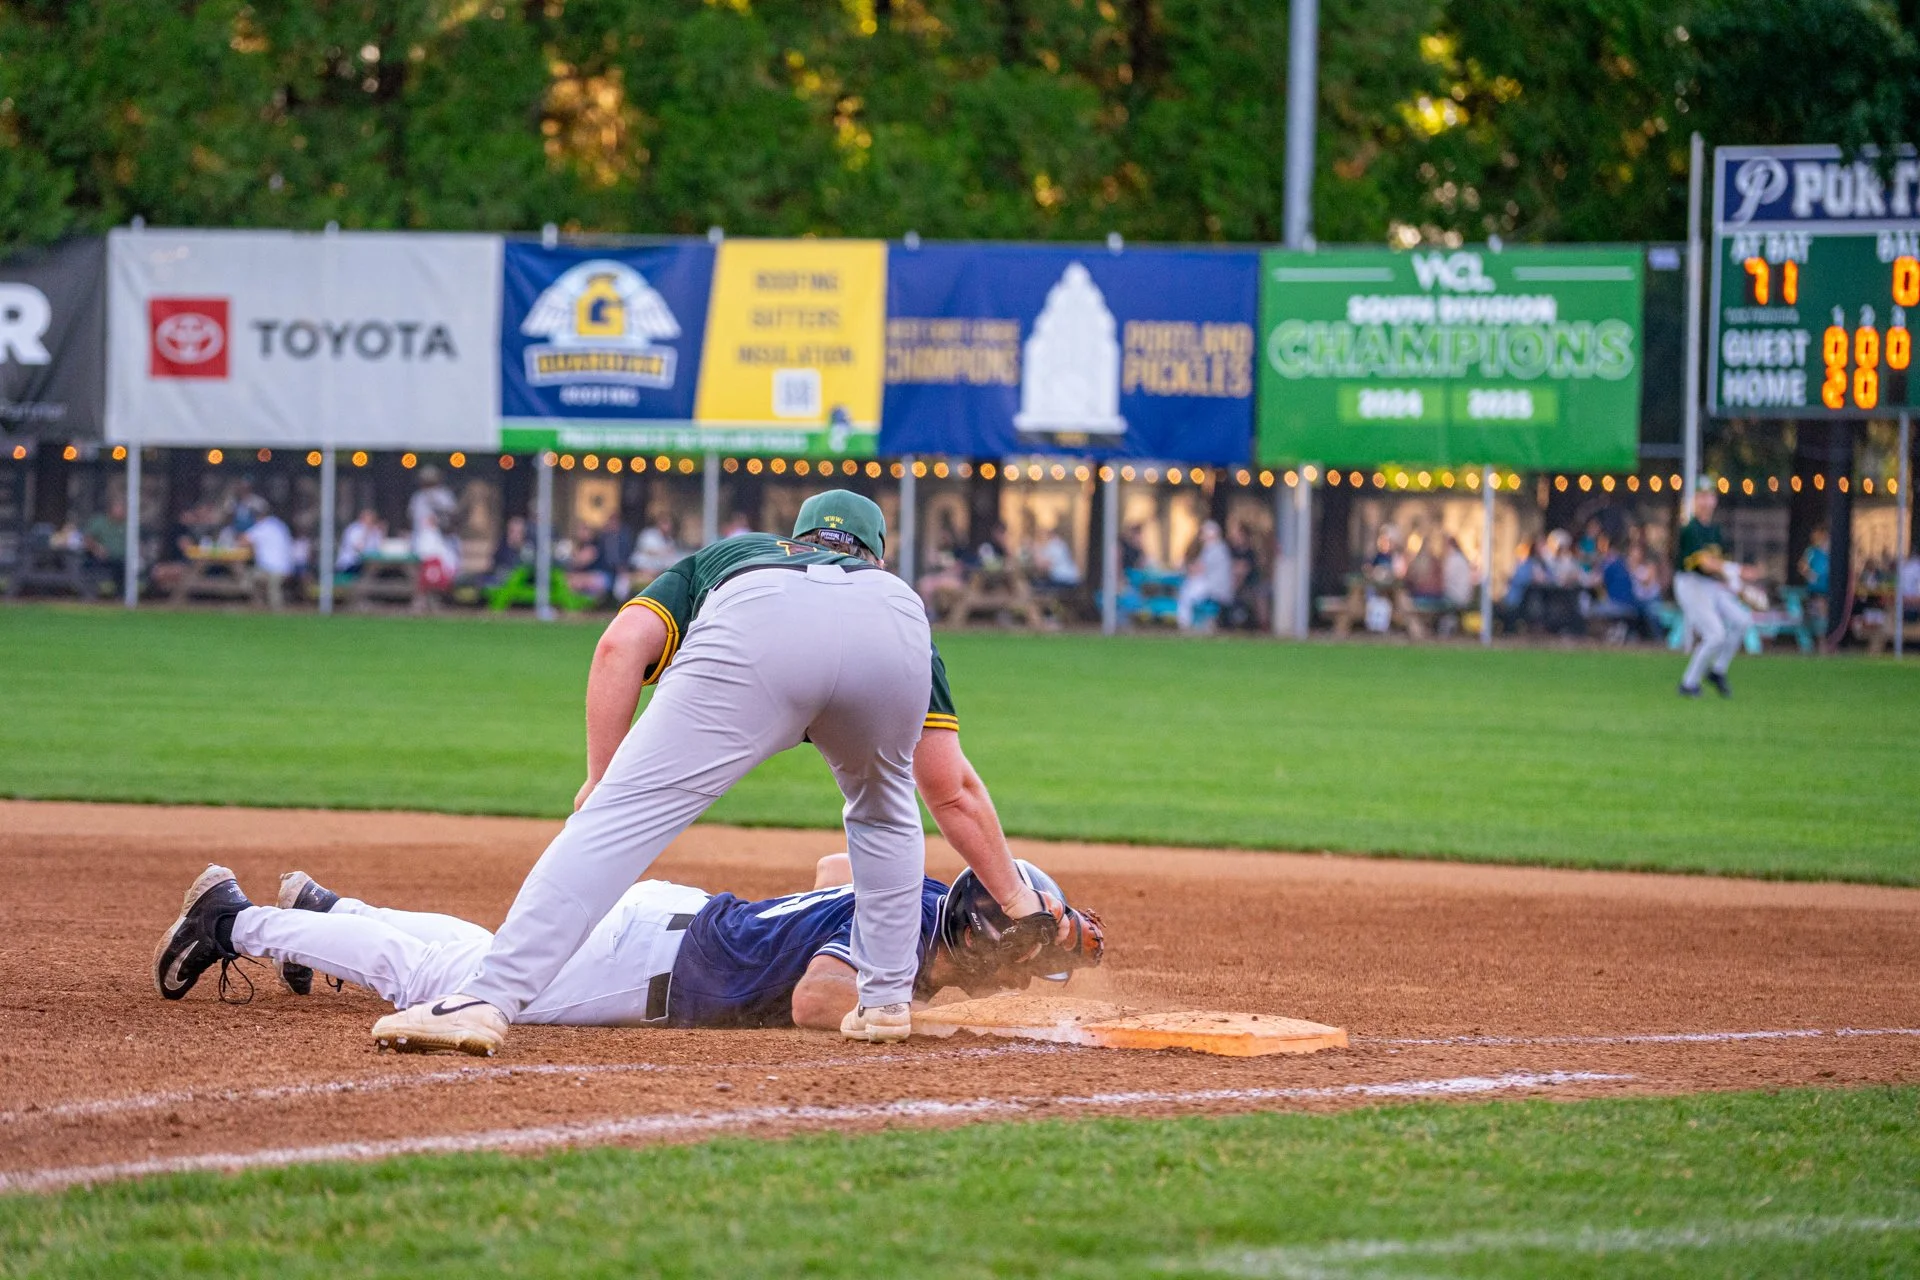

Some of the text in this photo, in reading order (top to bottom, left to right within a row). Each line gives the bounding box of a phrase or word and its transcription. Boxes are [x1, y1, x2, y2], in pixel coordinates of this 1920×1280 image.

[250, 319, 457, 361] TOYOTA
[1267, 319, 1635, 381] CHAMPIONS
[1722, 329, 1811, 367] GUEST
[1123, 356, 1253, 397] PICKLES
[1721, 368, 1807, 408] HOME
